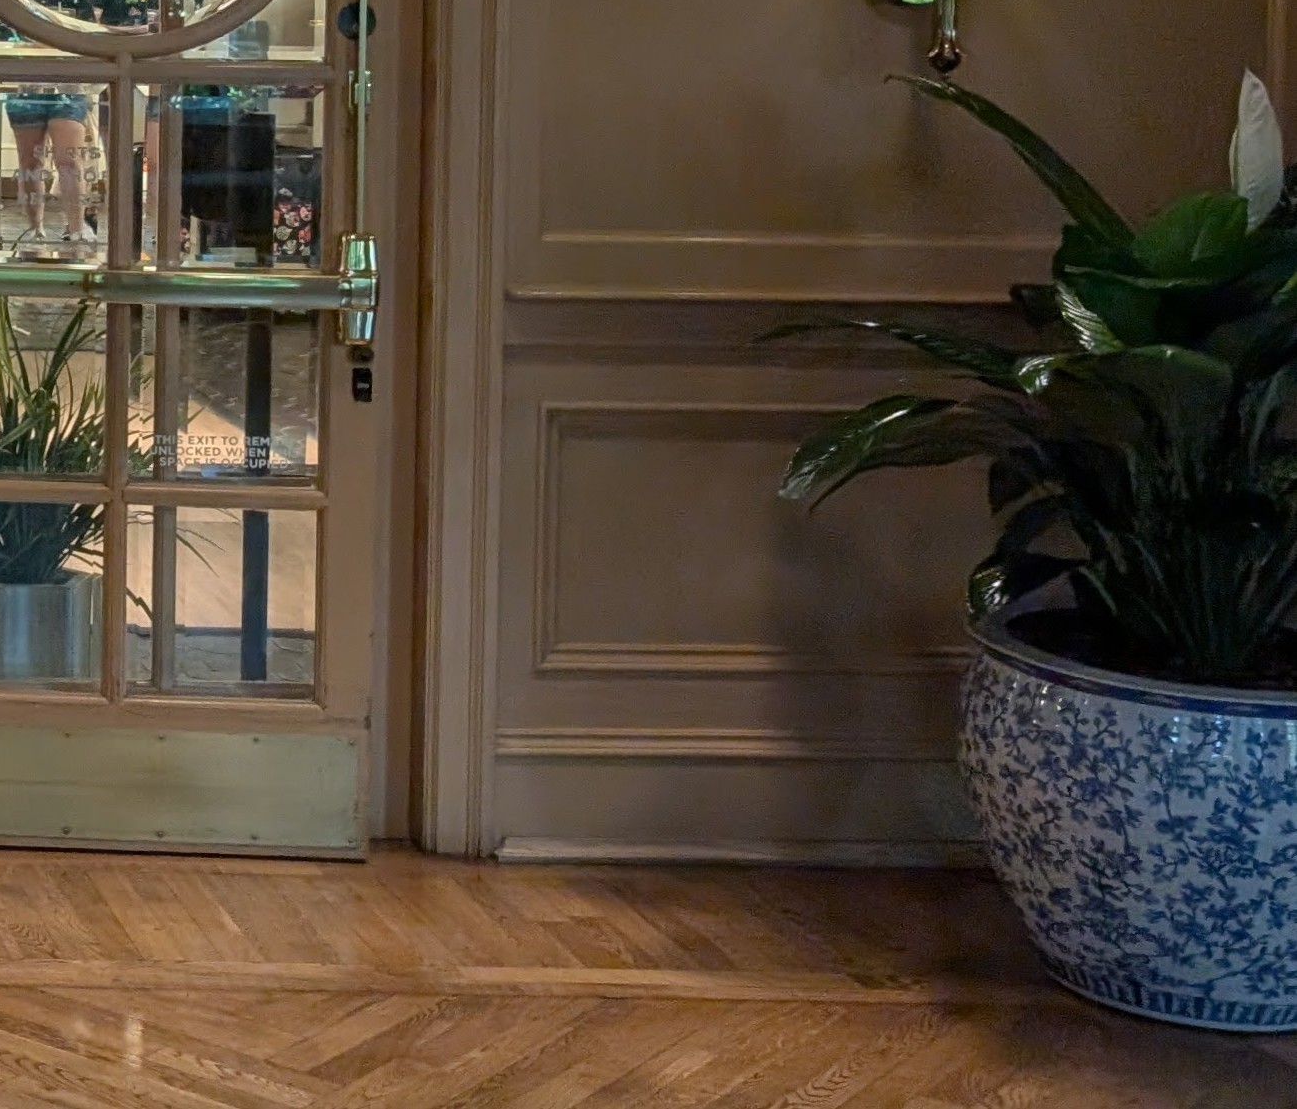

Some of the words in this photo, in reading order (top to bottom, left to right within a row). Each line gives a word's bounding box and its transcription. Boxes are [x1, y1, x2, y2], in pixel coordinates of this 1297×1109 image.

[33, 145, 101, 159] SHRTS
[155, 434, 184, 445] THIS
[188, 435, 217, 446] EXIT
[221, 435, 239, 446] TO
[151, 446, 221, 456] UNLOCKED
[226, 447, 267, 458] WHEN
[159, 456, 200, 468] SPACE
